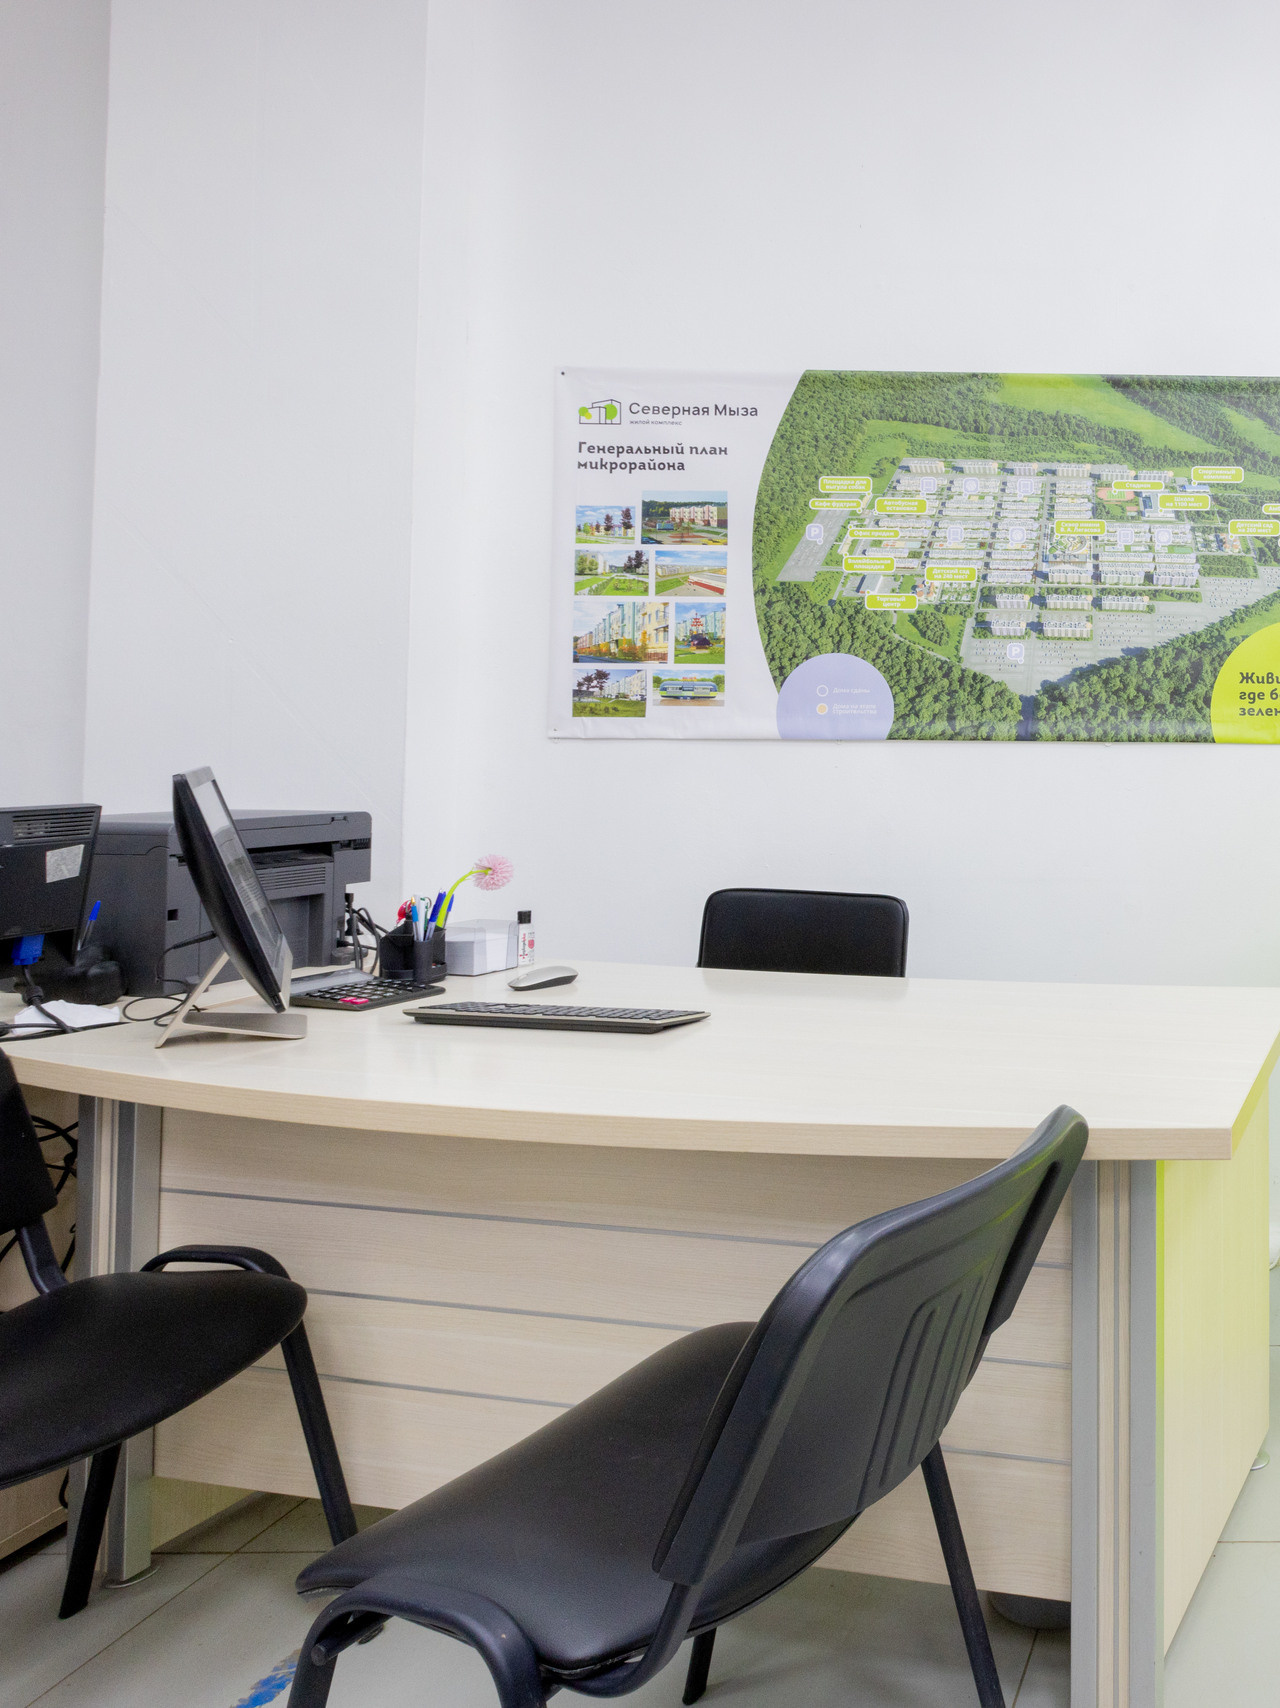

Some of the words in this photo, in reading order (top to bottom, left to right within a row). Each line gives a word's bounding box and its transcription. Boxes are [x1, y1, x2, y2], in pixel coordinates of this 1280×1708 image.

[629, 402, 710, 418] Северная
[714, 404, 758, 417] Мыза
[578, 441, 684, 458] Генеральный
[689, 445, 728, 456] план
[577, 458, 685, 474] микрорайона
[1239, 690, 1265, 704] где
